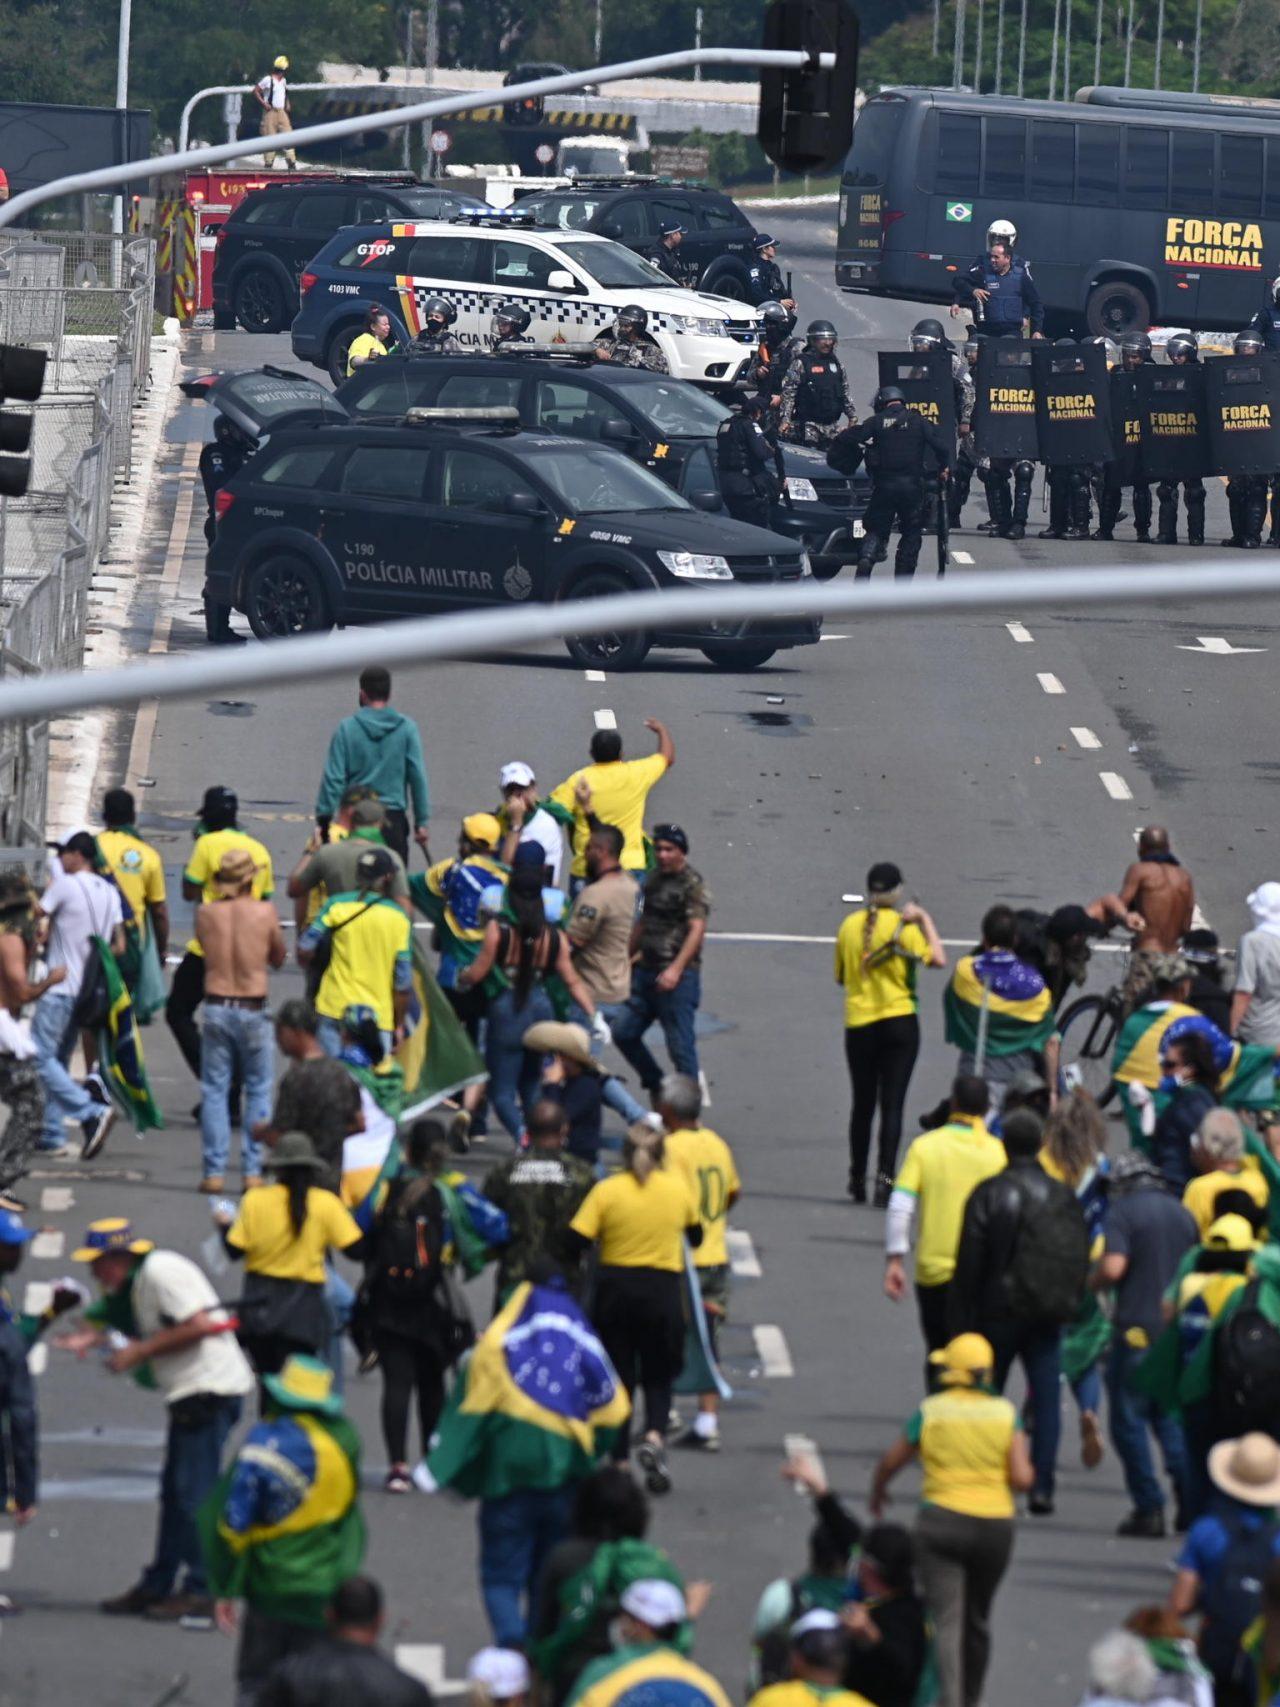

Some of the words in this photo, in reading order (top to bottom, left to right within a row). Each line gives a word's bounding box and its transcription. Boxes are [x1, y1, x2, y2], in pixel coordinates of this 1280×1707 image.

[1166, 217, 1264, 249] FORÇA
[357, 243, 396, 256] GTOP
[1165, 246, 1263, 267] NACIONAL
[328, 284, 345, 294] 4103
[345, 286, 360, 295] VMC
[1049, 408, 1096, 419] NACIONAL
[1152, 425, 1197, 436] NACIONAL
[1224, 418, 1271, 430] NACIONAL
[355, 543, 375, 556] 190
[344, 559, 418, 585] POLÍCIA
[419, 565, 495, 590] MILITAR
